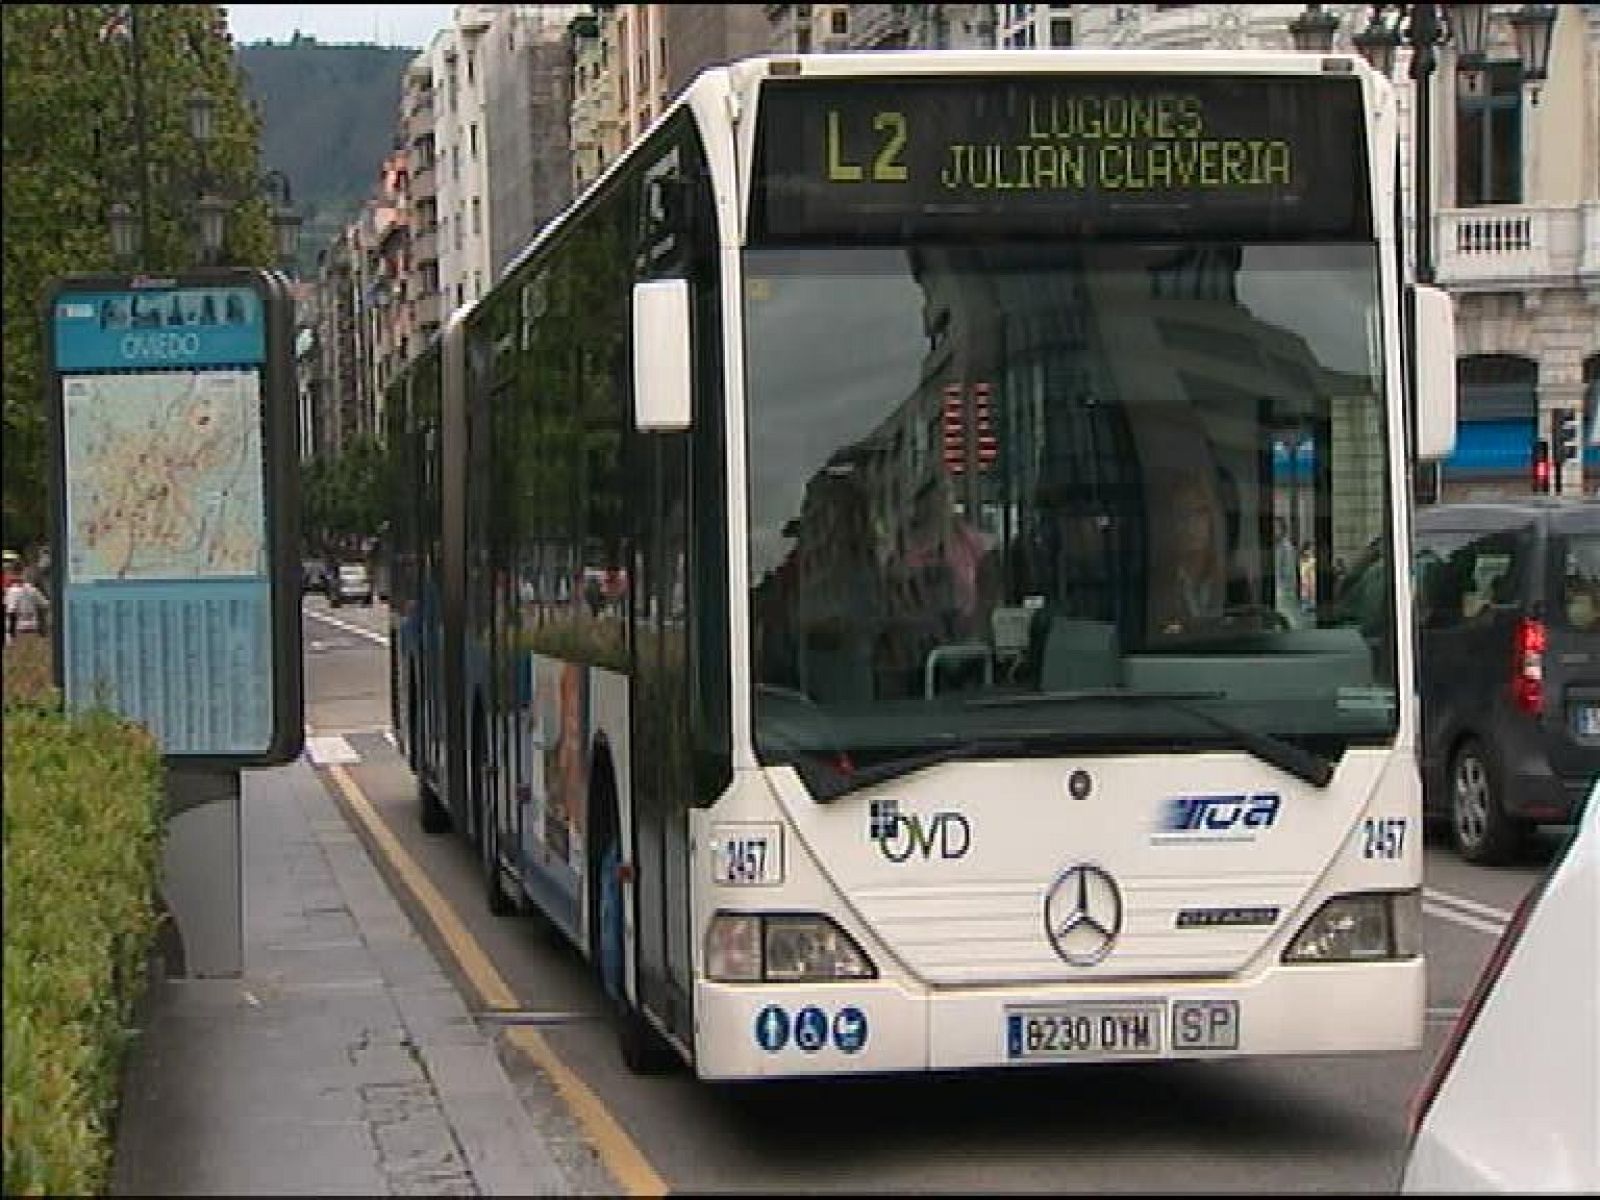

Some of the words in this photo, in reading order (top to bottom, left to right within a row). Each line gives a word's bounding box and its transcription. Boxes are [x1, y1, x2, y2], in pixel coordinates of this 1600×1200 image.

[1028, 95, 1204, 138] LUGONES
[825, 112, 908, 182] L2
[940, 144, 1086, 188] JULIAN
[1101, 140, 1292, 186] CLAVERIA
[880, 811, 971, 862] OVD
[1363, 817, 1406, 859] 2457
[727, 838, 767, 880] 2457
[1180, 1007, 1230, 1044] SP
